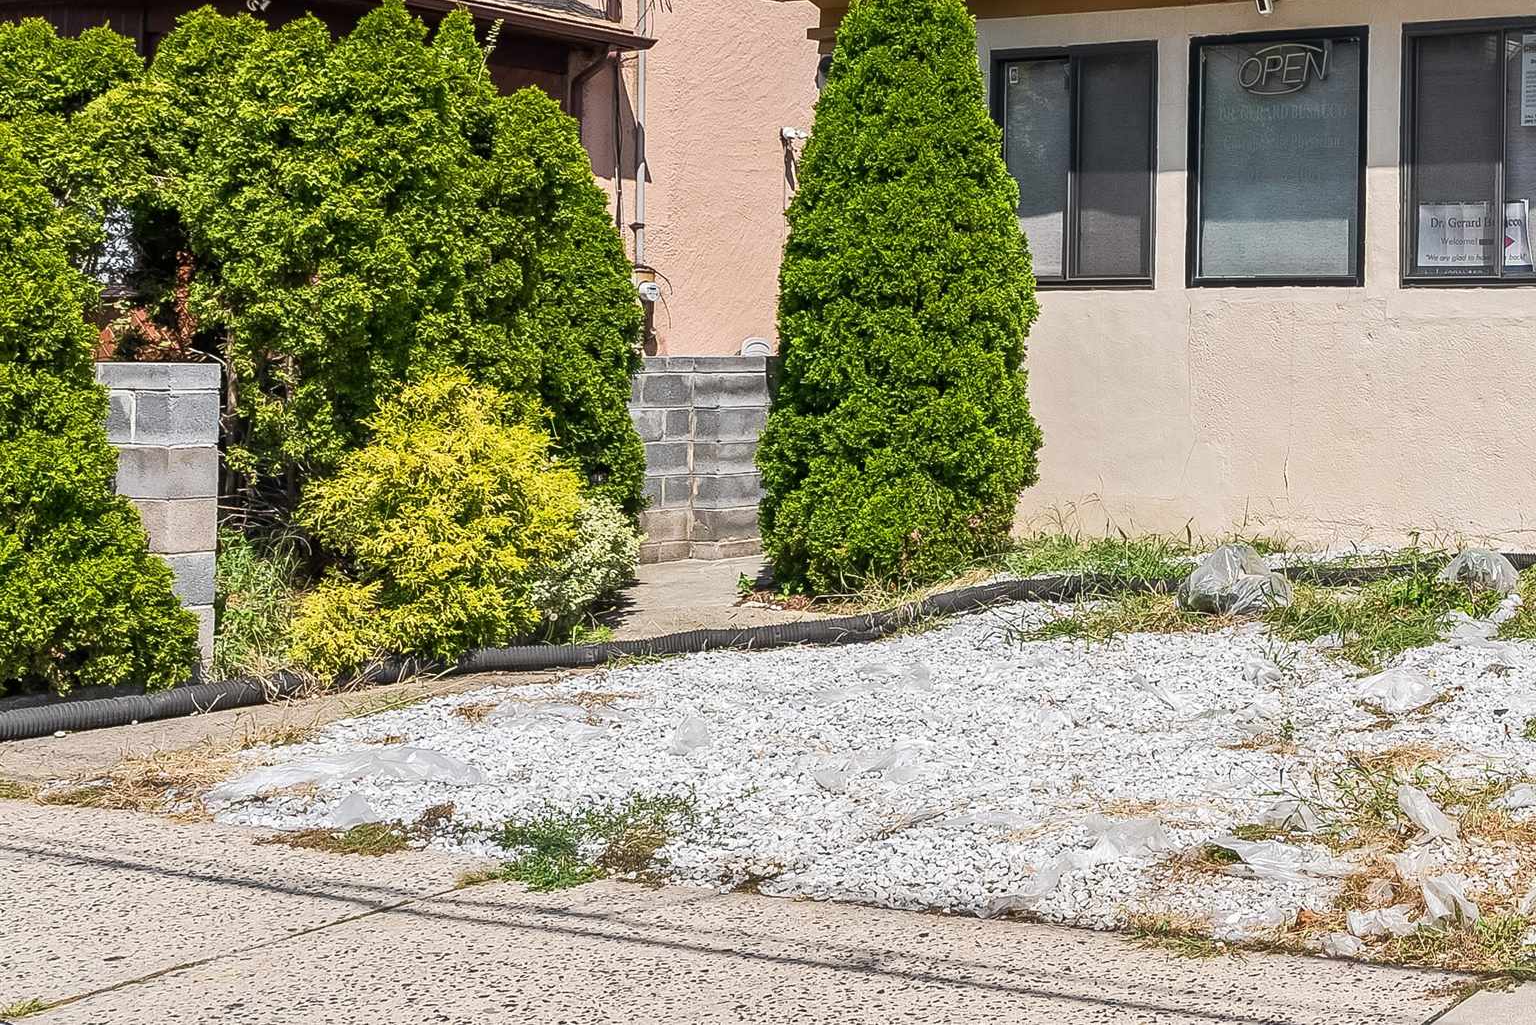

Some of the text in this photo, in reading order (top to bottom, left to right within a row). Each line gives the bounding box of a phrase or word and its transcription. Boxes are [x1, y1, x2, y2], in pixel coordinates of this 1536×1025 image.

[1238, 50, 1328, 88] OPEN
[1430, 217, 1445, 229] Dr.
[1447, 217, 1482, 229] Gerard
[1440, 237, 1478, 246] Welcome!
